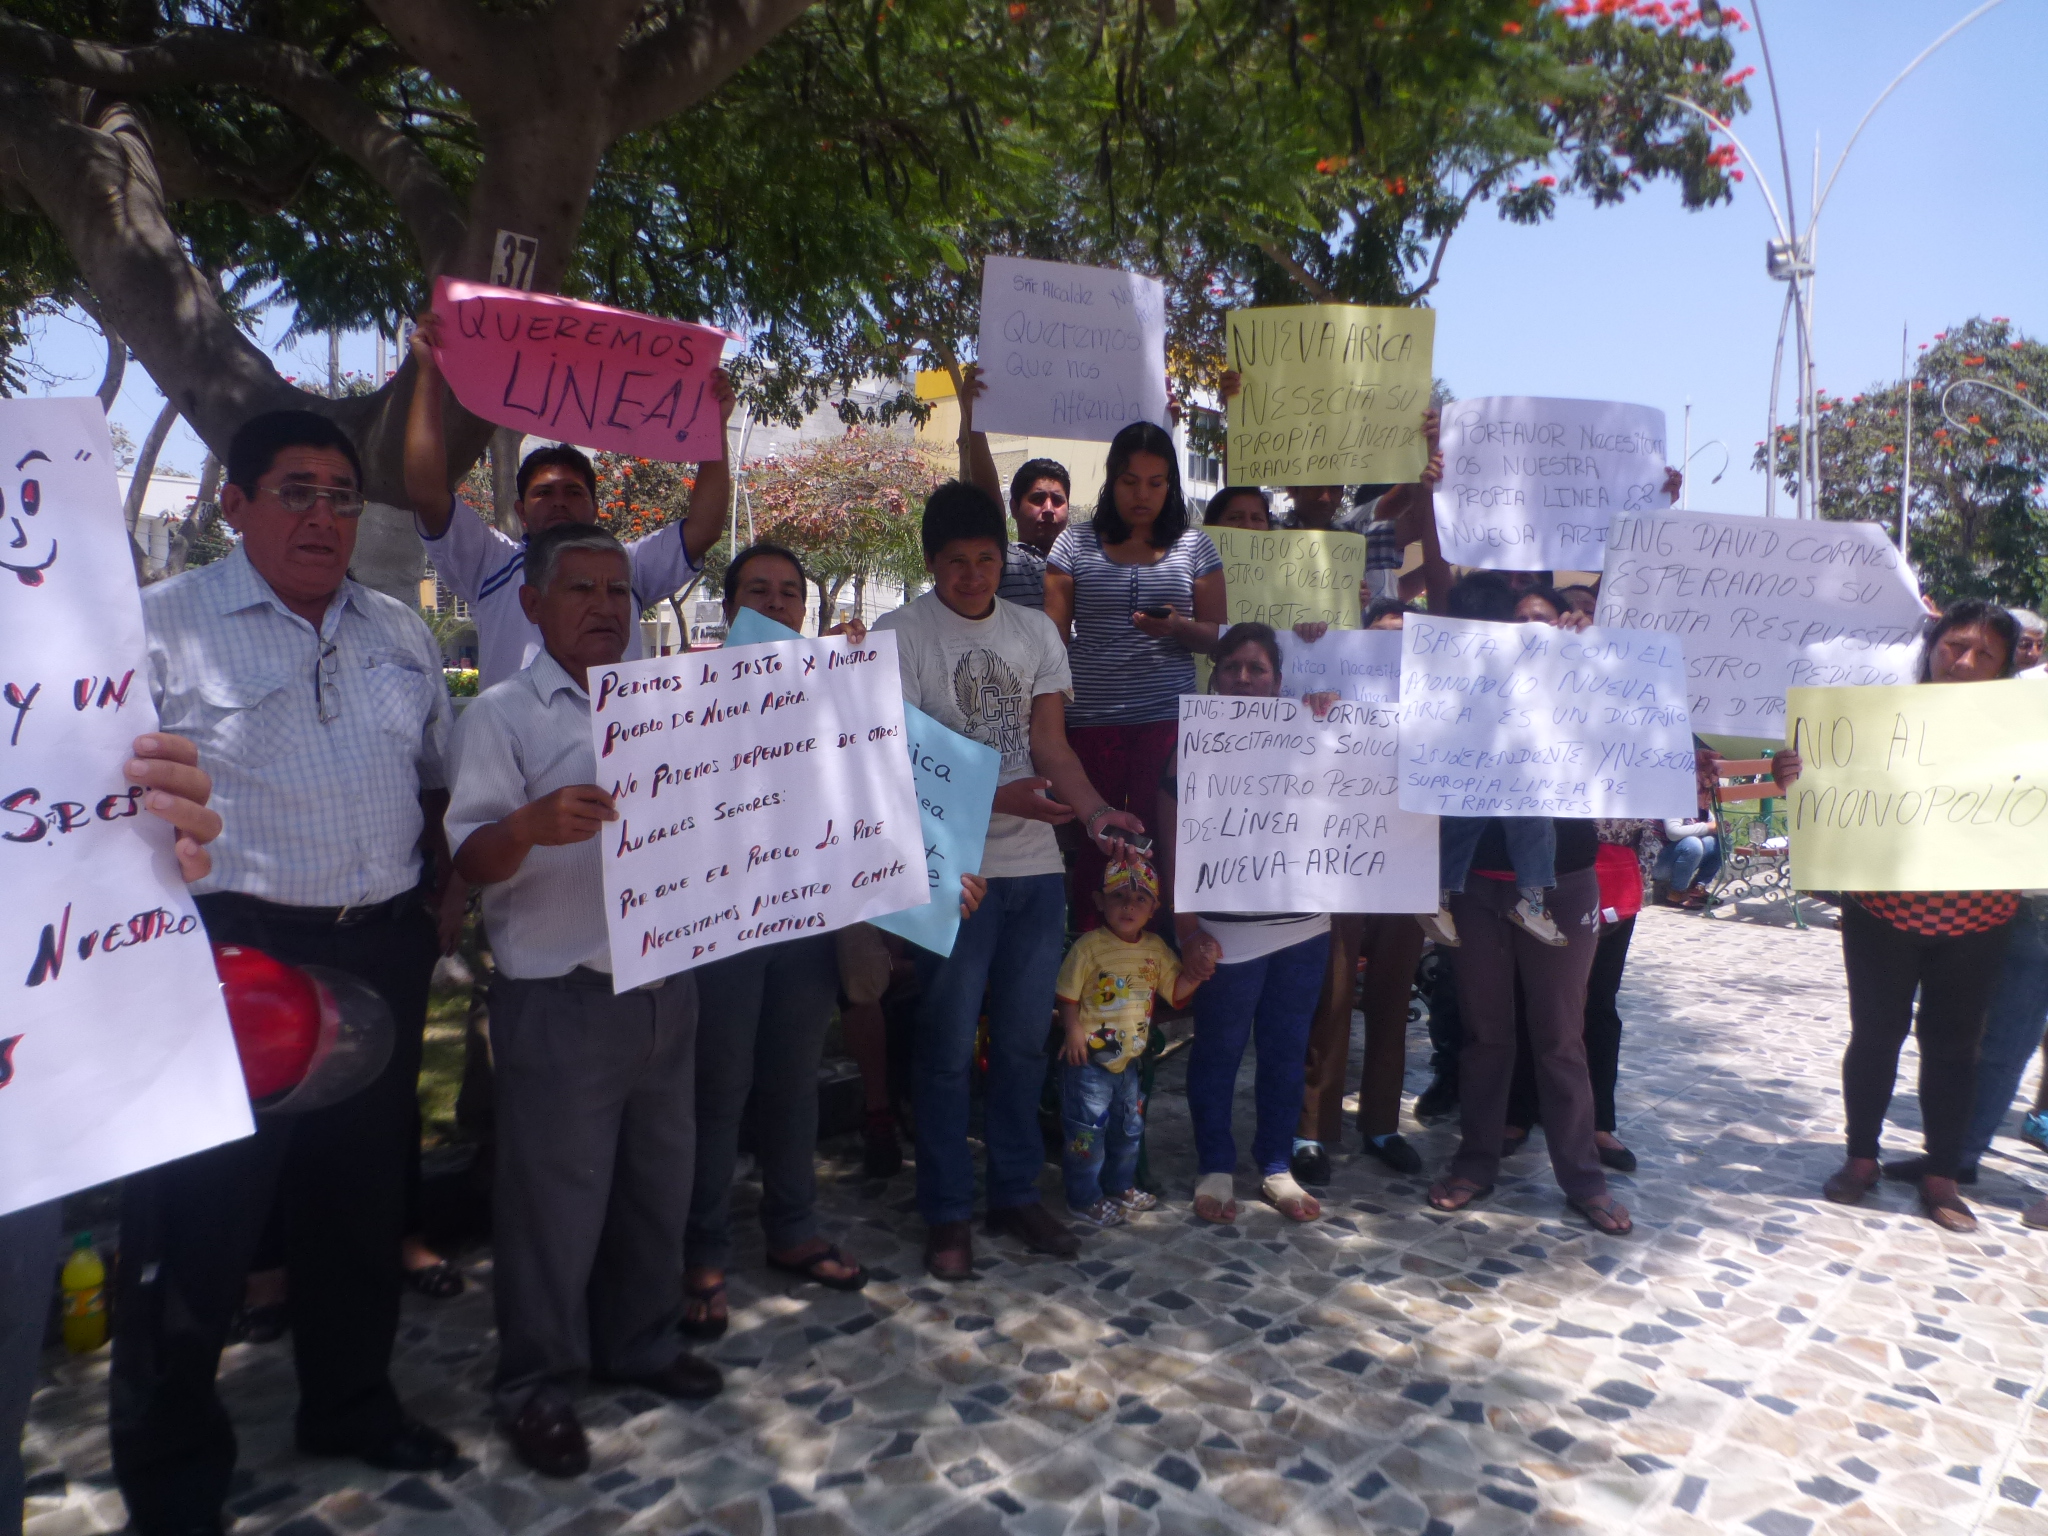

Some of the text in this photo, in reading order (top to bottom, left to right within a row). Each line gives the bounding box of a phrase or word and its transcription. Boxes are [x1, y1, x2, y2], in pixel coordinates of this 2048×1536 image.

[497, 234, 537, 290] 37
[457, 297, 694, 367] QUEREMOS
[1233, 319, 1335, 374] NUEVA
[1386, 385, 1418, 412] SU
[1233, 422, 1327, 461] PROPIA
[1232, 452, 1372, 483] TRANSPORTES
[1453, 483, 1609, 509] PROPIA LINEA
[1219, 532, 1363, 562] AL ABUSO CON
[1693, 521, 1779, 559] DAVID
[1279, 562, 1353, 589] PUEBLO
[1607, 559, 1884, 604] ESPERAMOS SU
[1322, 609, 1353, 629] DEL
[1600, 603, 1917, 653] PRONTA RESPUESTA
[1411, 623, 1498, 658] BASTA
[1560, 642, 1630, 661] CON
[1638, 646, 1673, 668] EL
[1405, 670, 1656, 701] MONOPOLIO NUEVA
[3, 668, 135, 746] Y UN
[1229, 698, 1297, 722] DAVID
[1498, 708, 1532, 727] ES
[1552, 710, 1588, 725] UN
[602, 720, 663, 758] PUEBLO
[672, 710, 695, 730] DE
[1793, 711, 1937, 780] NO AL
[611, 772, 638, 800] NO
[732, 737, 818, 772] DEPENDER
[837, 730, 857, 749] DE
[868, 725, 898, 742] OTROS
[1184, 771, 1197, 805] A
[1207, 773, 1315, 798] NUESTRO
[1510, 777, 1586, 796] LINEA
[1601, 778, 1628, 795] DE
[1796, 774, 2048, 831] MONOPOLIO
[1323, 813, 1387, 839] PARA
[619, 888, 649, 919] POR
[706, 864, 730, 883] EL
[746, 844, 800, 873] PUEBLO
[641, 904, 740, 957] NECESITAMOS
[751, 882, 832, 917] NUESTRO
[25, 902, 197, 987] NUESTRO
[692, 941, 717, 960] DE
